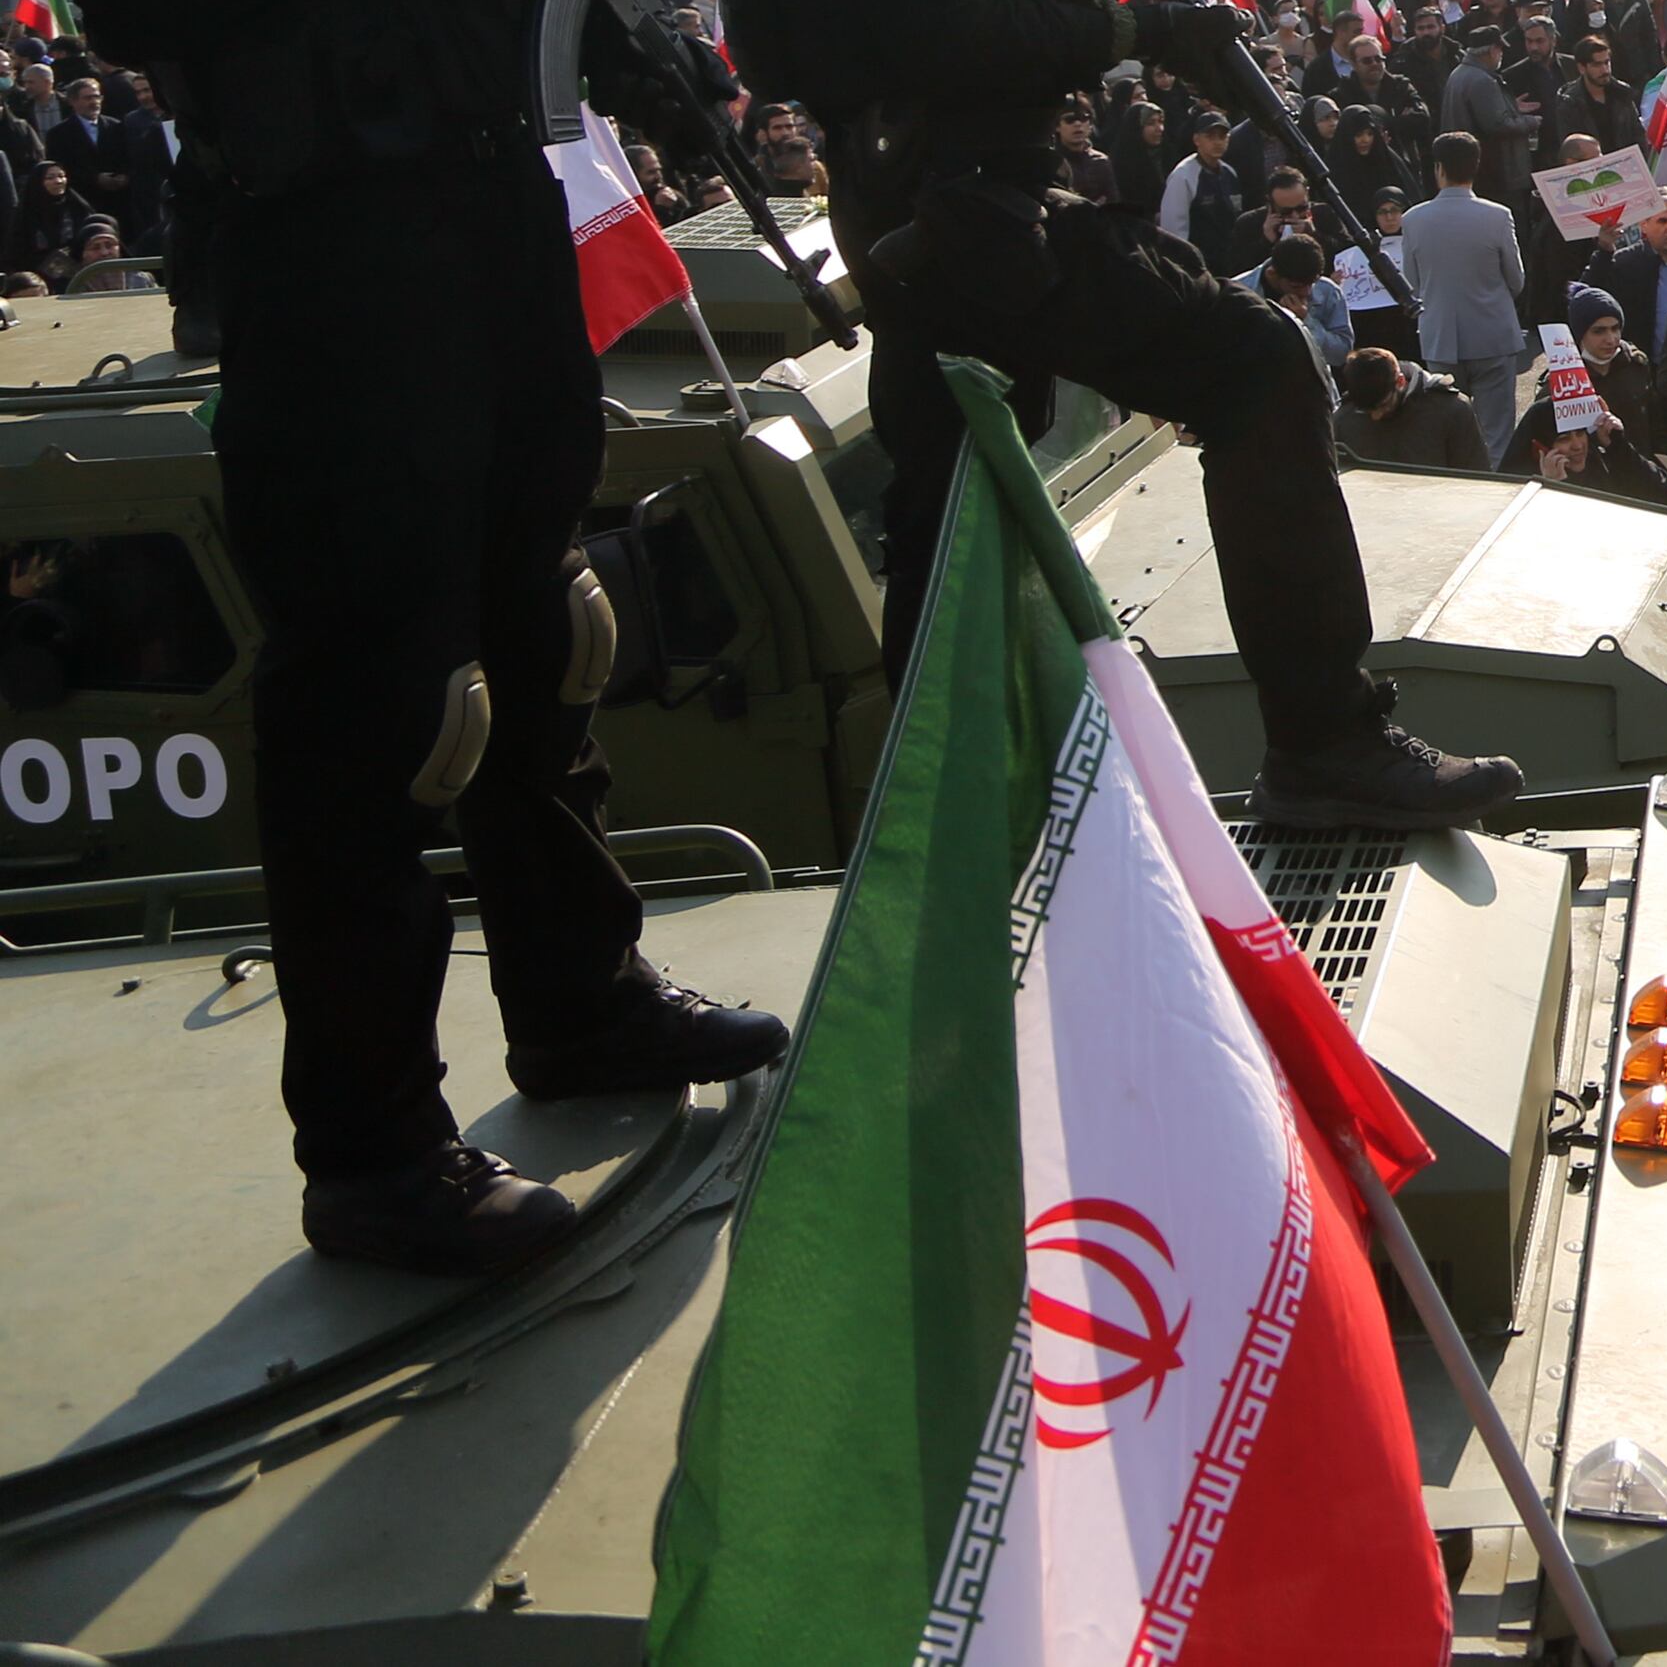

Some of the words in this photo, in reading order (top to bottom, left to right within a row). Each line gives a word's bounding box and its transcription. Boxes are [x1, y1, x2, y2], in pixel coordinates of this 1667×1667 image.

[1556, 400, 1586, 420] DOWN
[1587, 399, 1600, 414] WI
[0, 731, 229, 824] OPO
